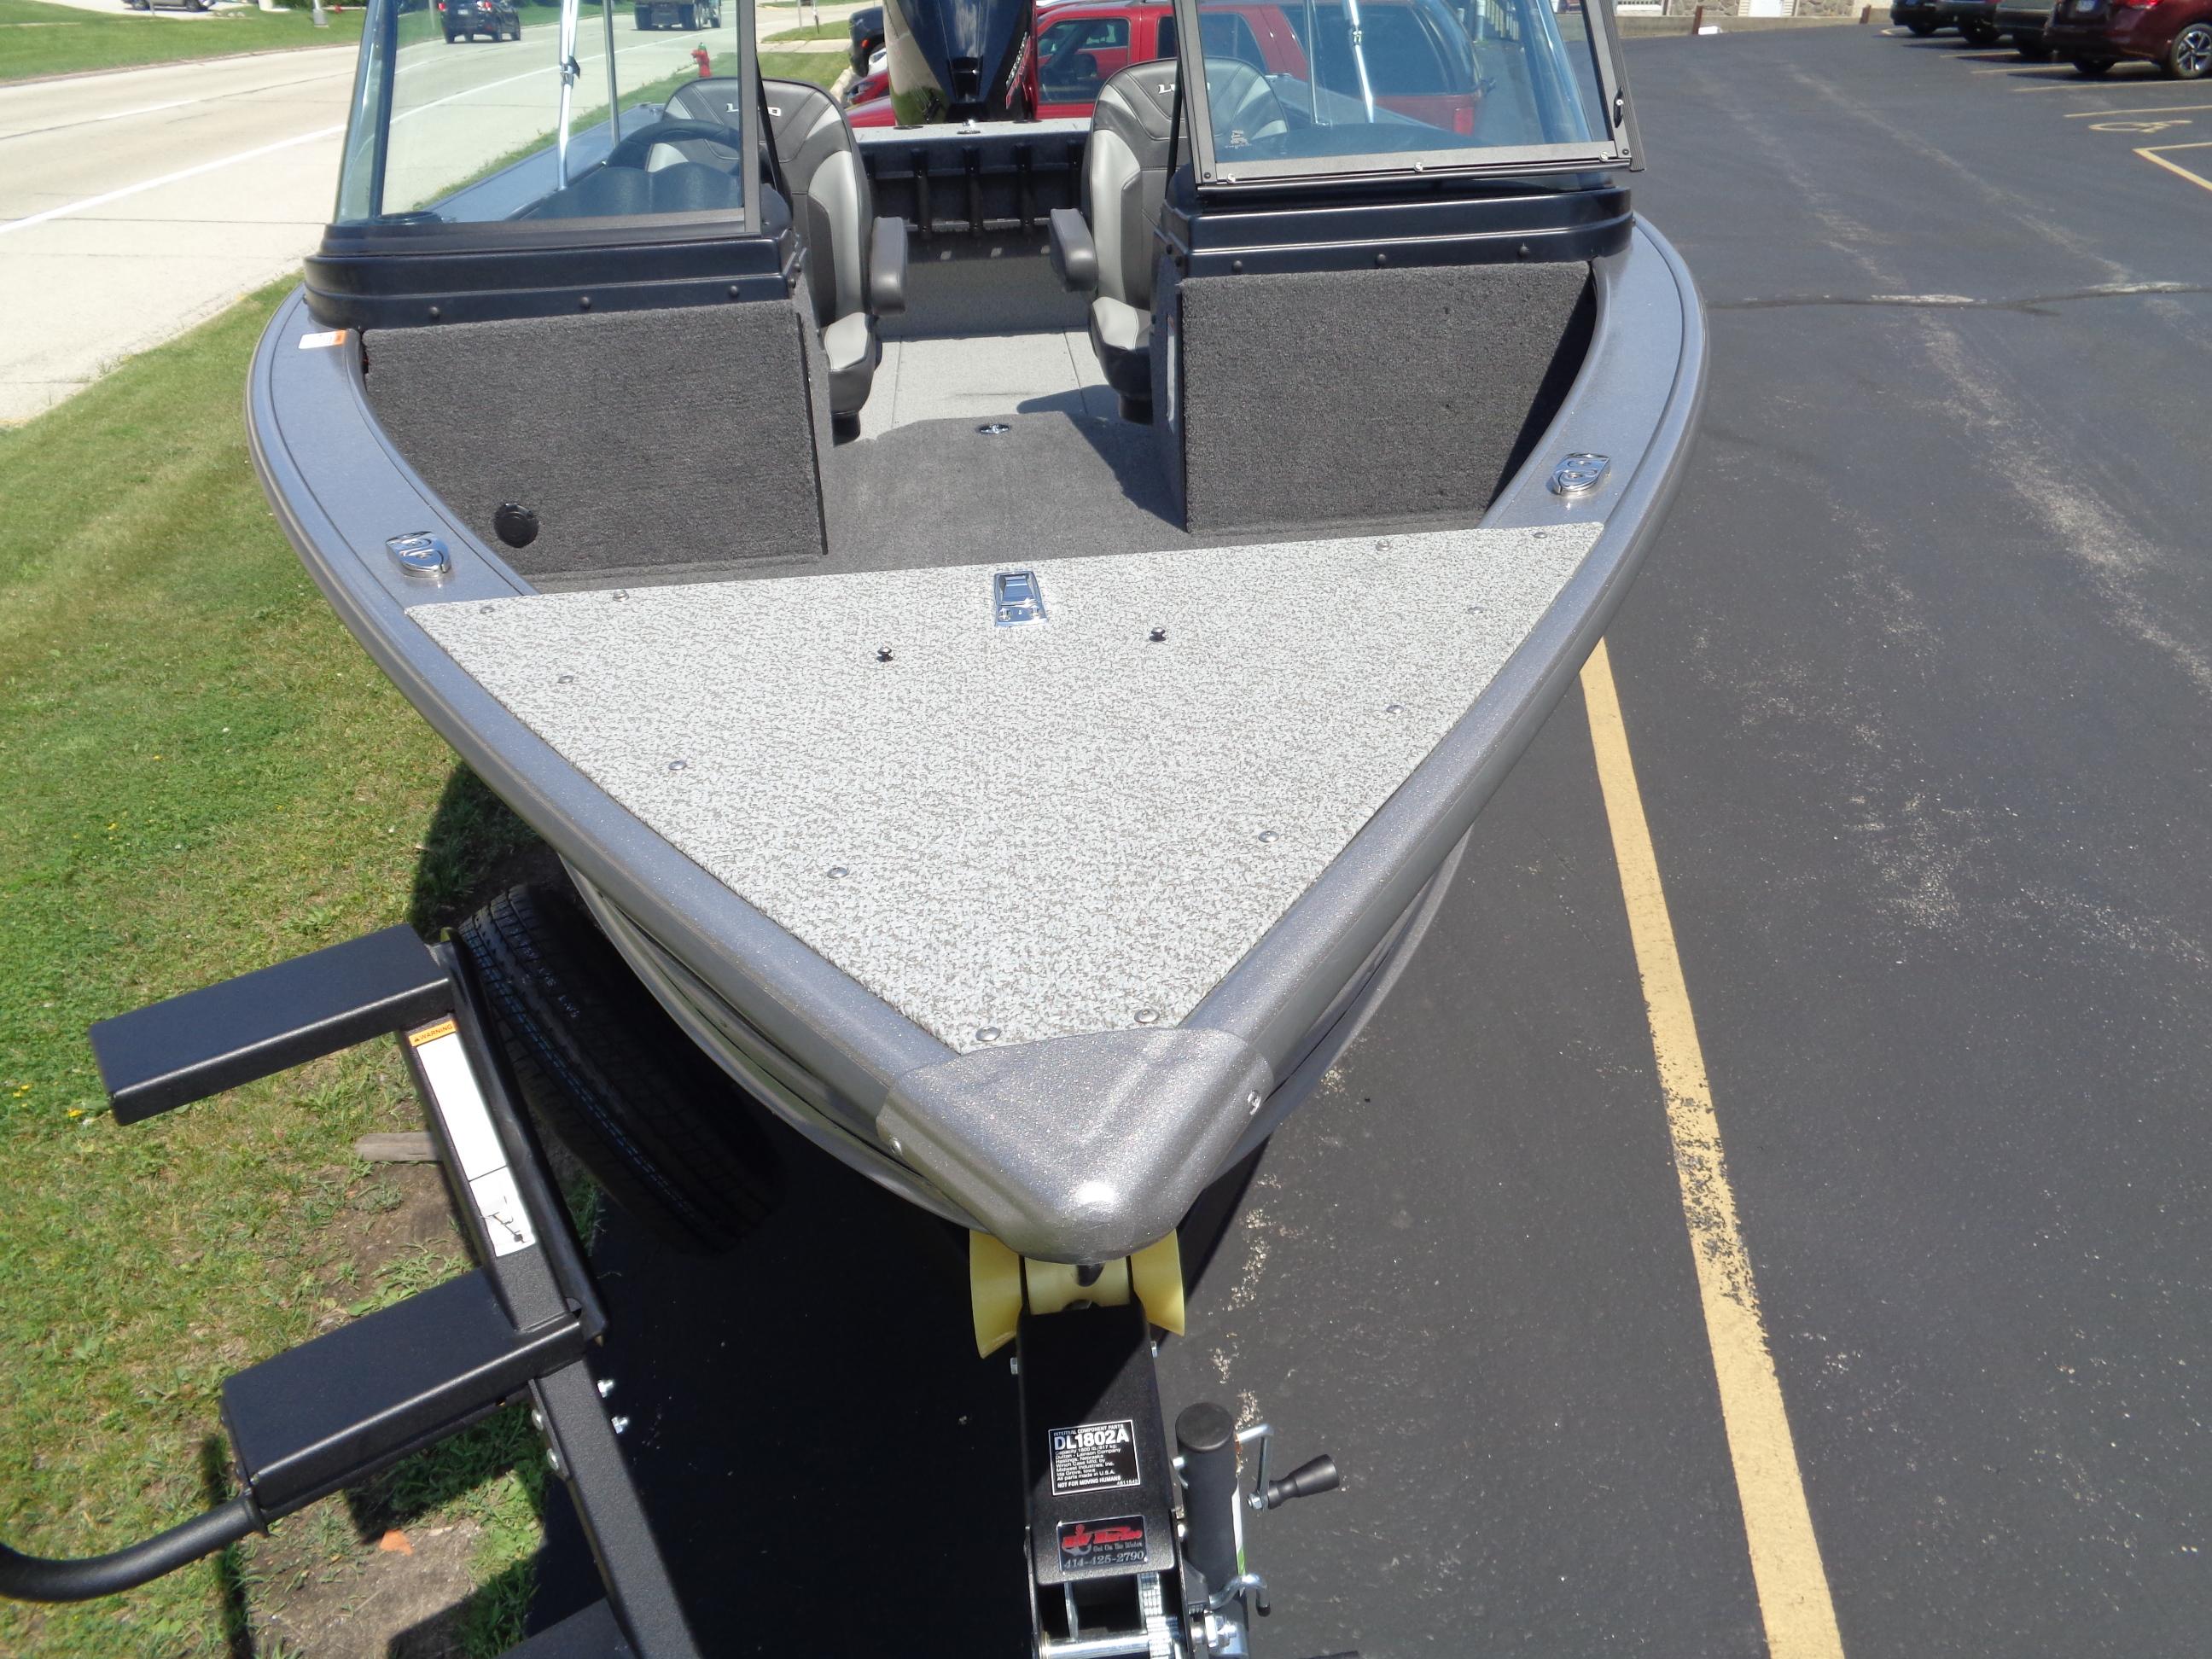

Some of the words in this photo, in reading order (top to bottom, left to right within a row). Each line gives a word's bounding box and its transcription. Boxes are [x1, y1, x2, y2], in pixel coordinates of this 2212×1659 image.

[421, 1024, 452, 1039] WARNING
[1055, 1429, 1129, 1451] DL1802A
[1064, 1551, 1144, 1569] 414-425-2790
